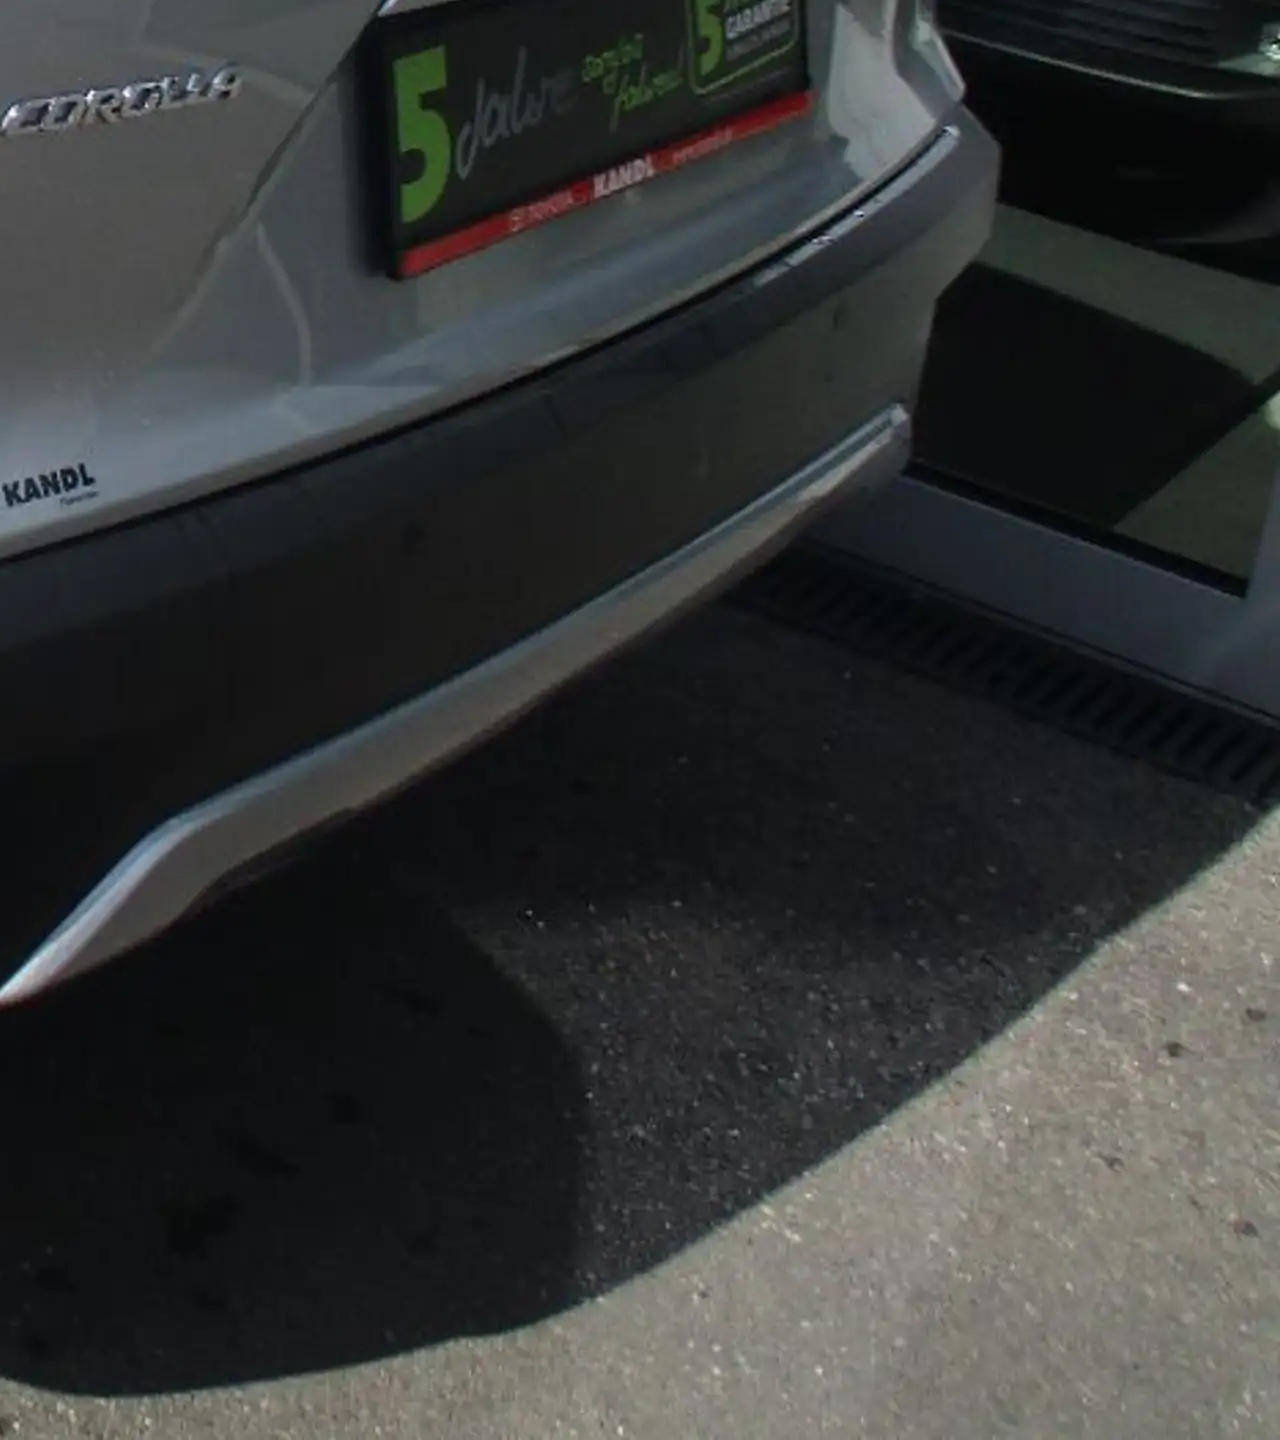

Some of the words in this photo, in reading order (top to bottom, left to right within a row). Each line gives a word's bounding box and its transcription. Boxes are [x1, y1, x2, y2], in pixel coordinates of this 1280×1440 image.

[392, 44, 451, 224] 5
[592, 154, 657, 198] KANDL
[1, 462, 97, 507] KANDL
